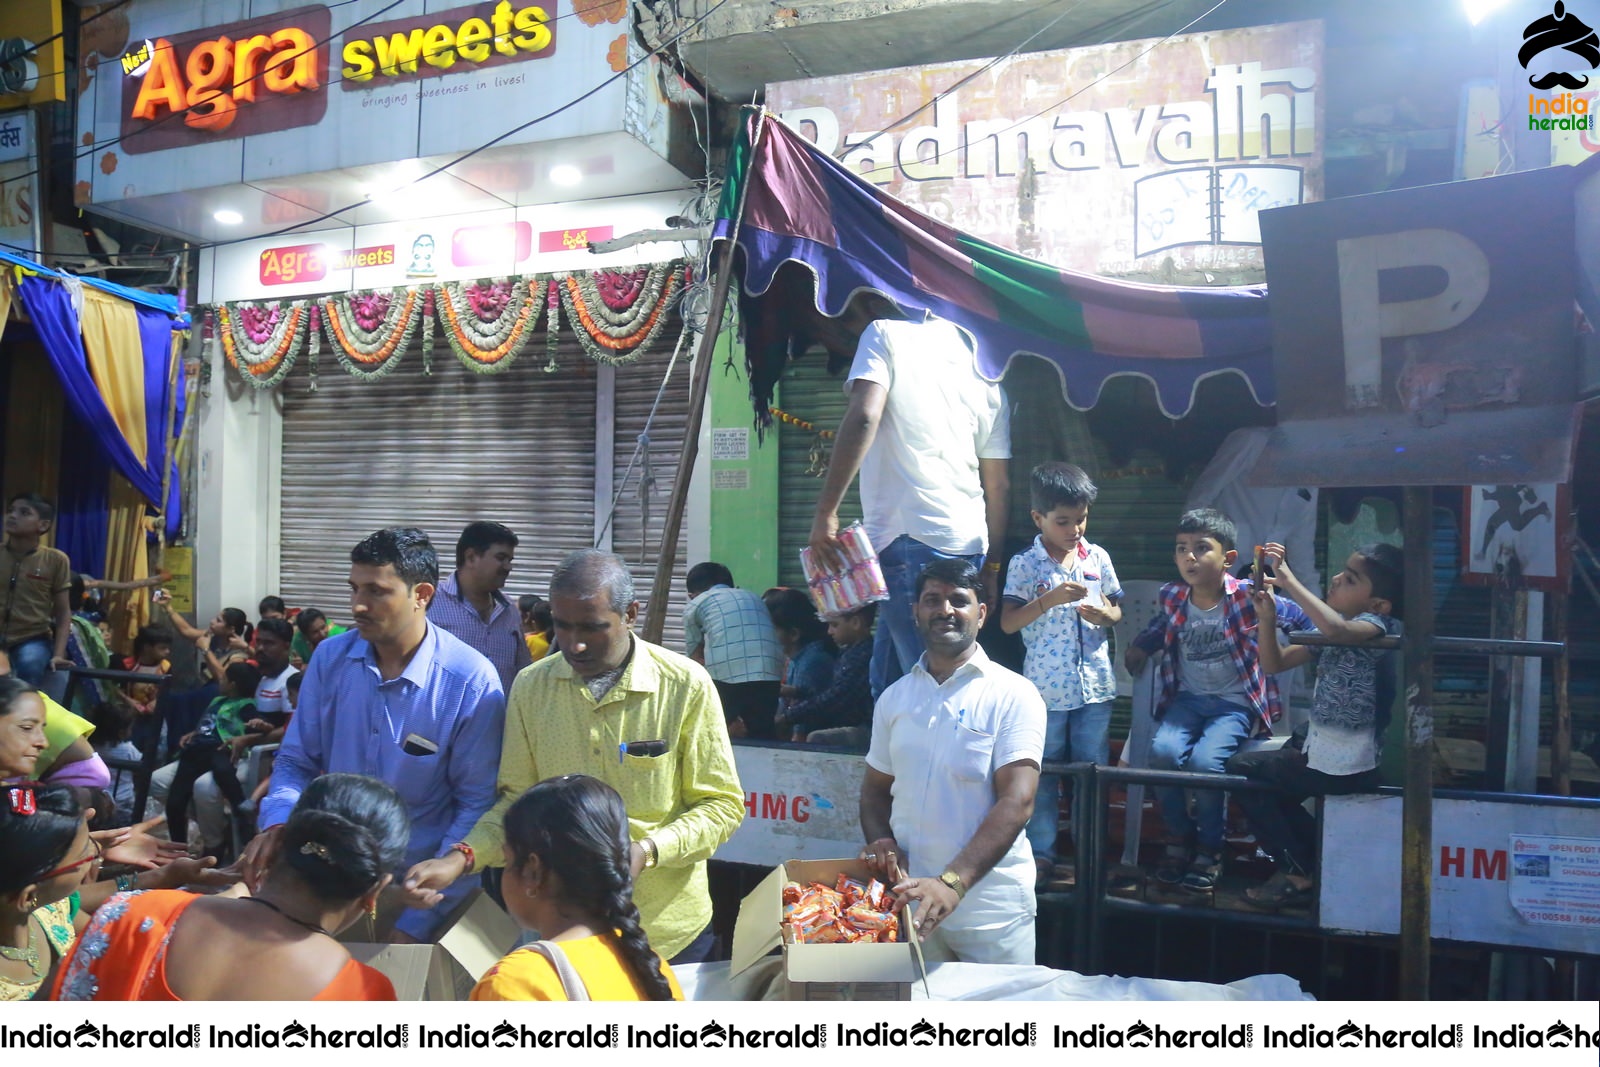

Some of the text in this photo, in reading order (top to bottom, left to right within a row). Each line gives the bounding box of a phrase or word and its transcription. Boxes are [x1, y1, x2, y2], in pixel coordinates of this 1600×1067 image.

[132, 27, 320, 132] Agra
[341, 0, 552, 82] sweets
[361, 73, 526, 108] bringing sweetness in lives!
[780, 61, 1317, 183] Padmavathi
[264, 250, 322, 282] Agra
[1337, 228, 1490, 411] P
